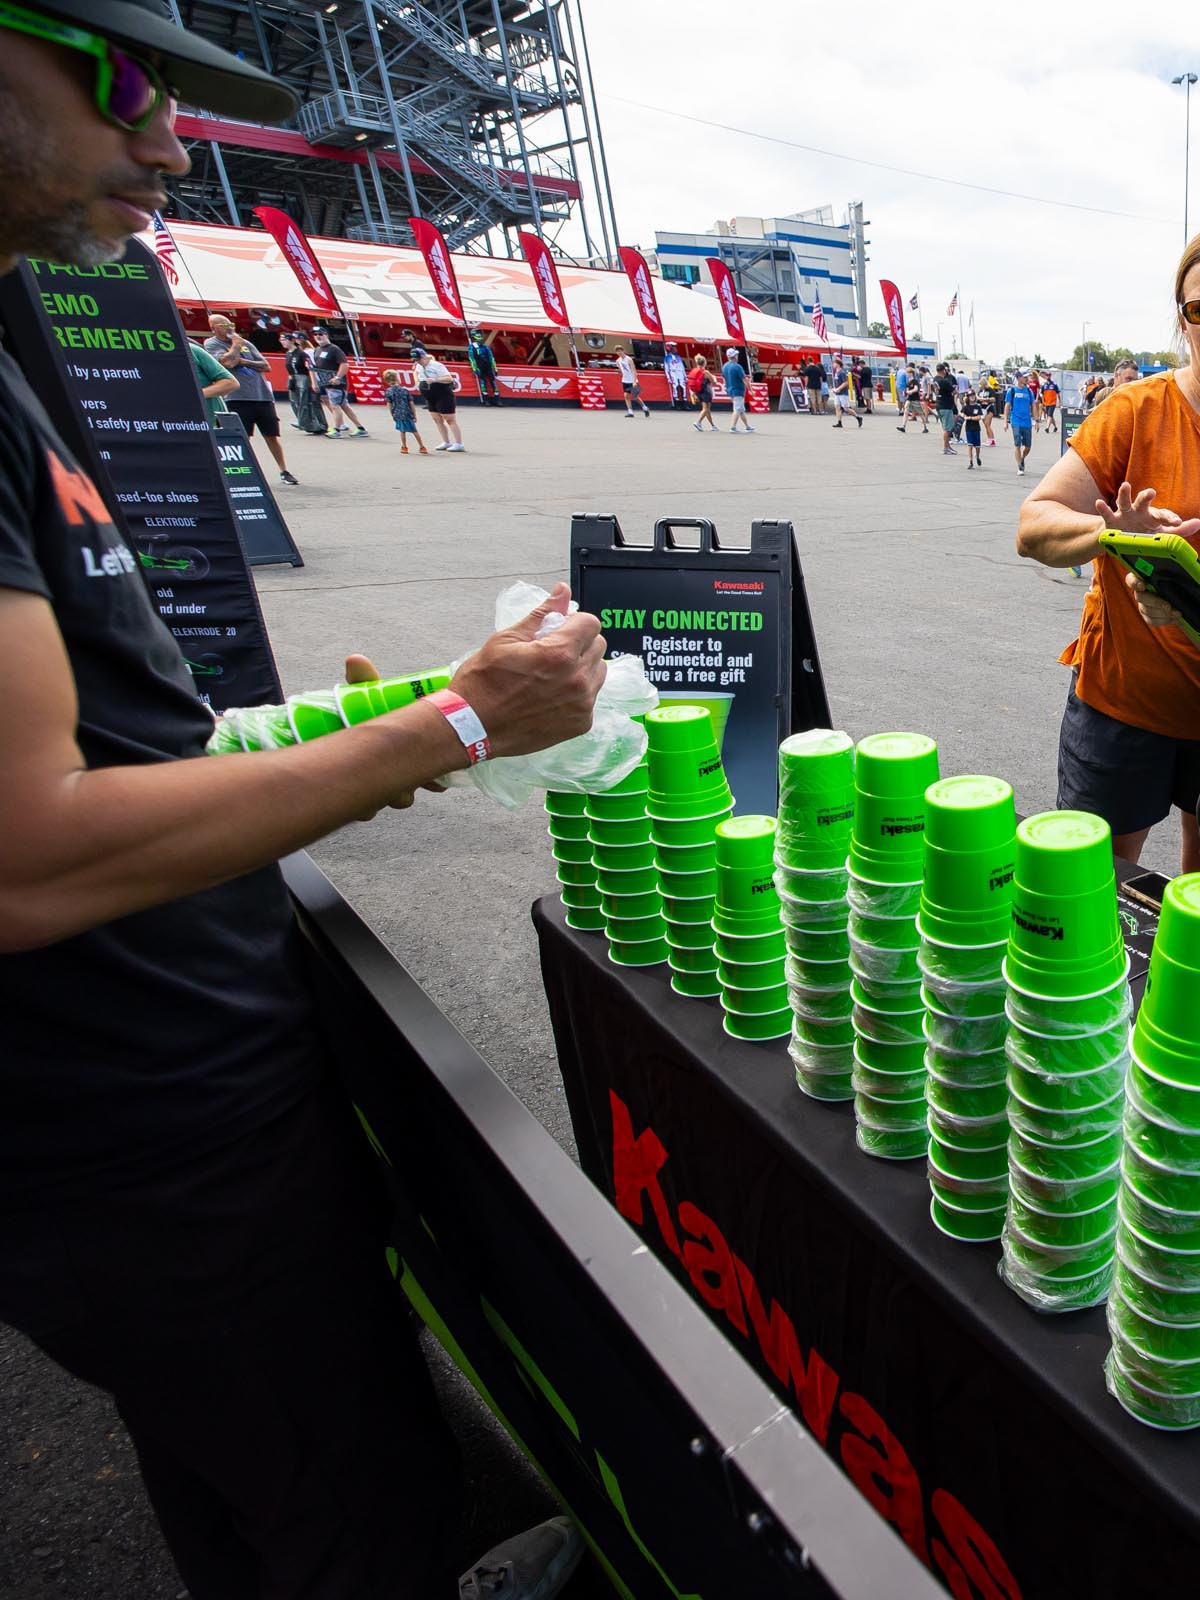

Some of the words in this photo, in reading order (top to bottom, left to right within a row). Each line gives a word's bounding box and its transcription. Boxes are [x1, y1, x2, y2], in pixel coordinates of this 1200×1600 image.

[73, 365, 89, 380] by
[92, 368, 101, 378] a
[102, 367, 142, 381] parent
[496, 375, 571, 391] FLY
[95, 417, 131, 432] safety
[133, 419, 159, 432] gear
[161, 420, 210, 432] (provided)
[166, 491, 200, 503] shoes
[144, 517, 198, 527] ELEKTRODE
[157, 588, 174, 598] old
[714, 581, 764, 590] Kawasaki
[176, 604, 206, 614] under
[600, 609, 646, 629] STAY
[653, 610, 763, 631] CONNECTED
[171, 627, 221, 636] ELEKTRODE
[226, 627, 237, 636] 20
[643, 636, 703, 654] Register
[707, 638, 722, 652] to
[647, 651, 722, 667] Connected
[727, 653, 753, 667] and
[674, 671, 684, 682] a
[687, 668, 716, 682] free
[720, 669, 746, 686] gift
